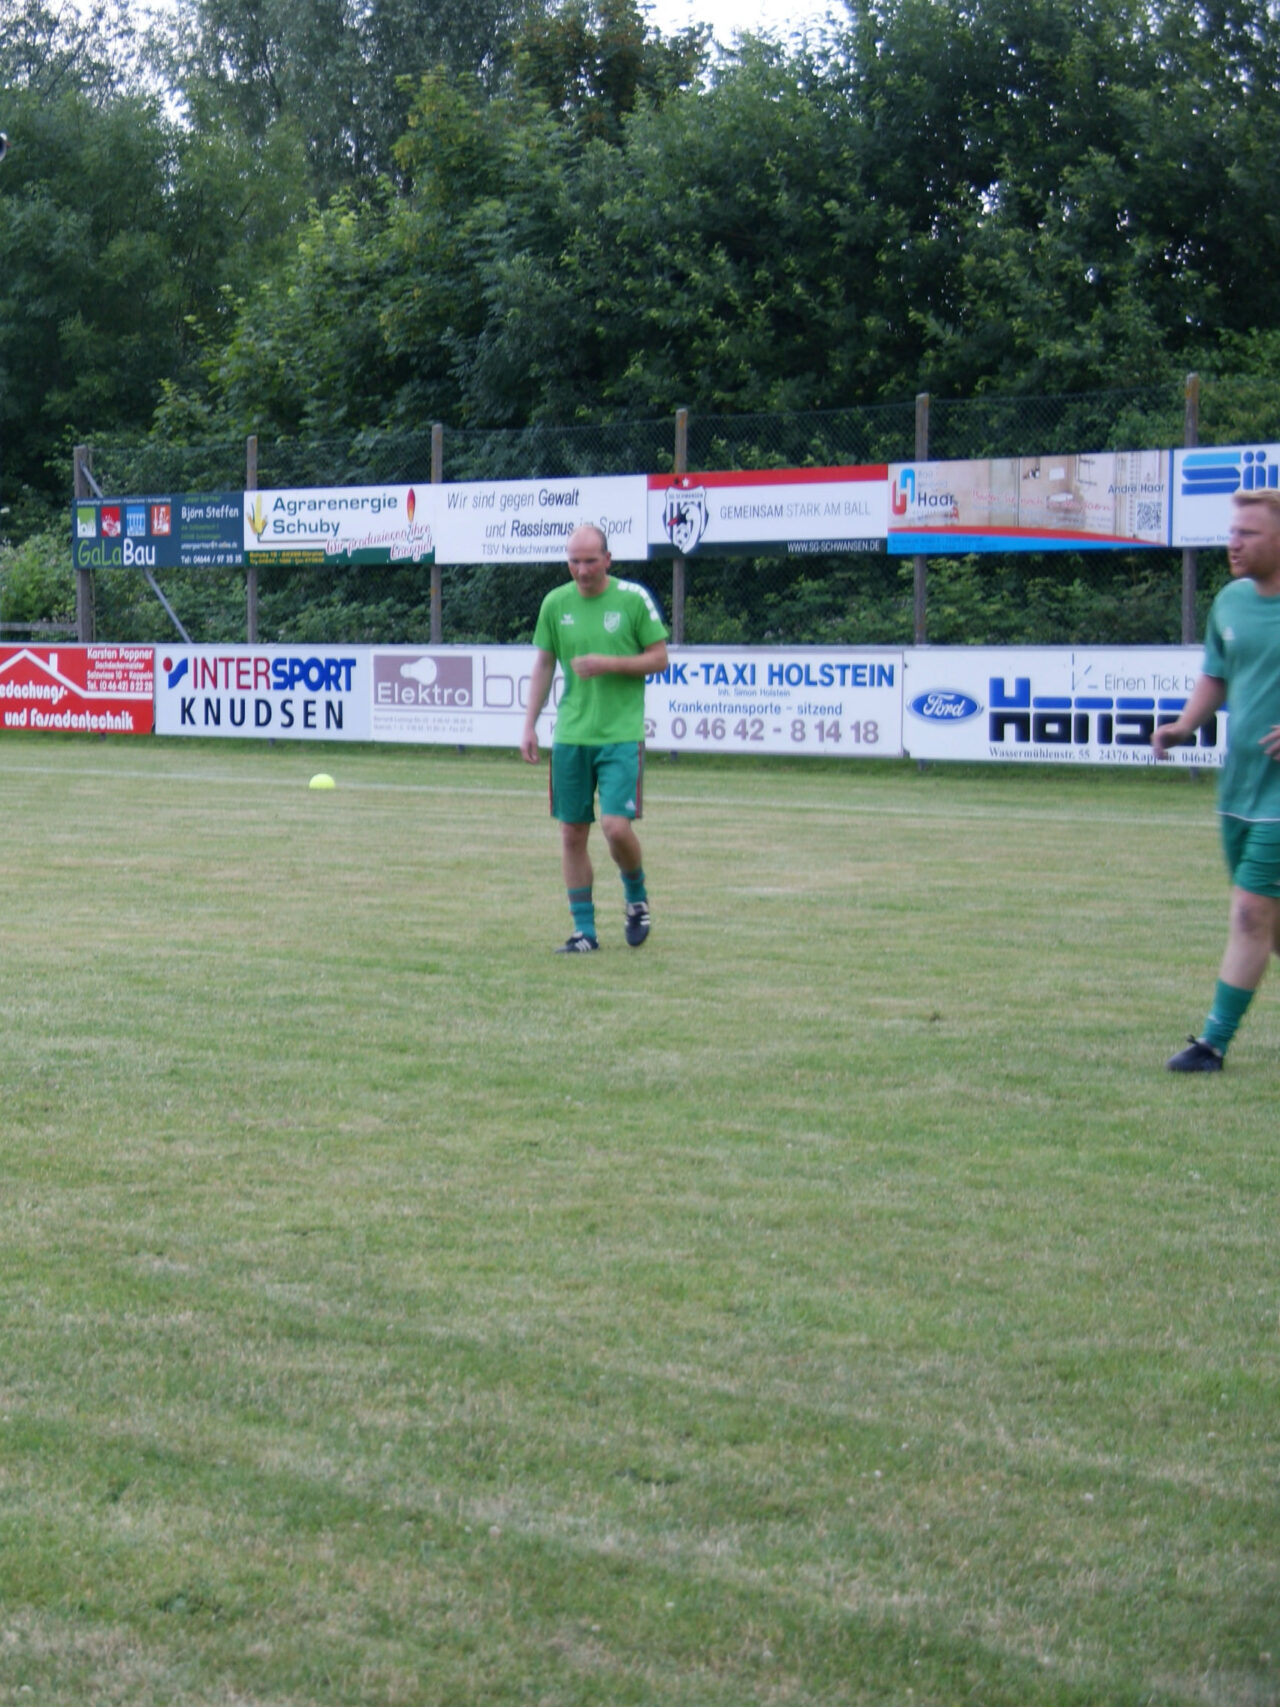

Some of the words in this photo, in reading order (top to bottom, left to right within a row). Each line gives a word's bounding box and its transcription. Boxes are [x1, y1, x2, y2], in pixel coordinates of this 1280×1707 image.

[1140, 483, 1164, 494] Haar
[272, 493, 398, 516] Agrarenergie
[447, 493, 467, 509] Wir
[472, 491, 495, 508] sind
[500, 493, 535, 512] gegen
[538, 488, 579, 507] Gewalt
[917, 492, 955, 507] Haar
[181, 506, 203, 523] Björn
[205, 504, 239, 519] Steffen
[720, 505, 783, 520] GEMEINSAM
[786, 503, 821, 518] STARK
[824, 502, 841, 516] AM
[844, 501, 870, 516] BALL
[273, 518, 341, 537] Schuby
[485, 523, 506, 538] und
[510, 519, 574, 537] Rassismus
[599, 516, 632, 538] Sport
[347, 527, 406, 557] produzieren
[481, 544, 500, 555] TSV
[77, 538, 156, 566] GaLaBau
[87, 647, 118, 660] Karsten
[193, 657, 357, 692] INTERSPORT
[768, 663, 895, 688] HOLSTEIN
[1104, 674, 1146, 690] Einen
[1150, 673, 1180, 691] Tick
[87, 681, 98, 691] Tel.
[377, 680, 470, 706] Elektro
[734, 688, 757, 697] Simon
[759, 688, 790, 697] Holstein
[181, 696, 344, 729] KNUDSEN
[668, 700, 781, 717] Krankentransporte
[797, 701, 843, 716] sitzend
[922, 694, 967, 718] Ford
[5, 710, 28, 728] und
[671, 717, 687, 740] 0
[695, 718, 726, 741] 46
[733, 718, 765, 741] 42
[790, 719, 806, 742] 8
[815, 719, 842, 743] 14
[850, 720, 879, 744] 18
[988, 747, 1075, 760] Wassermühlenstr.
[1079, 748, 1091, 760] 55
[1099, 749, 1129, 762] 24376
[1132, 751, 1176, 766] Kappn
